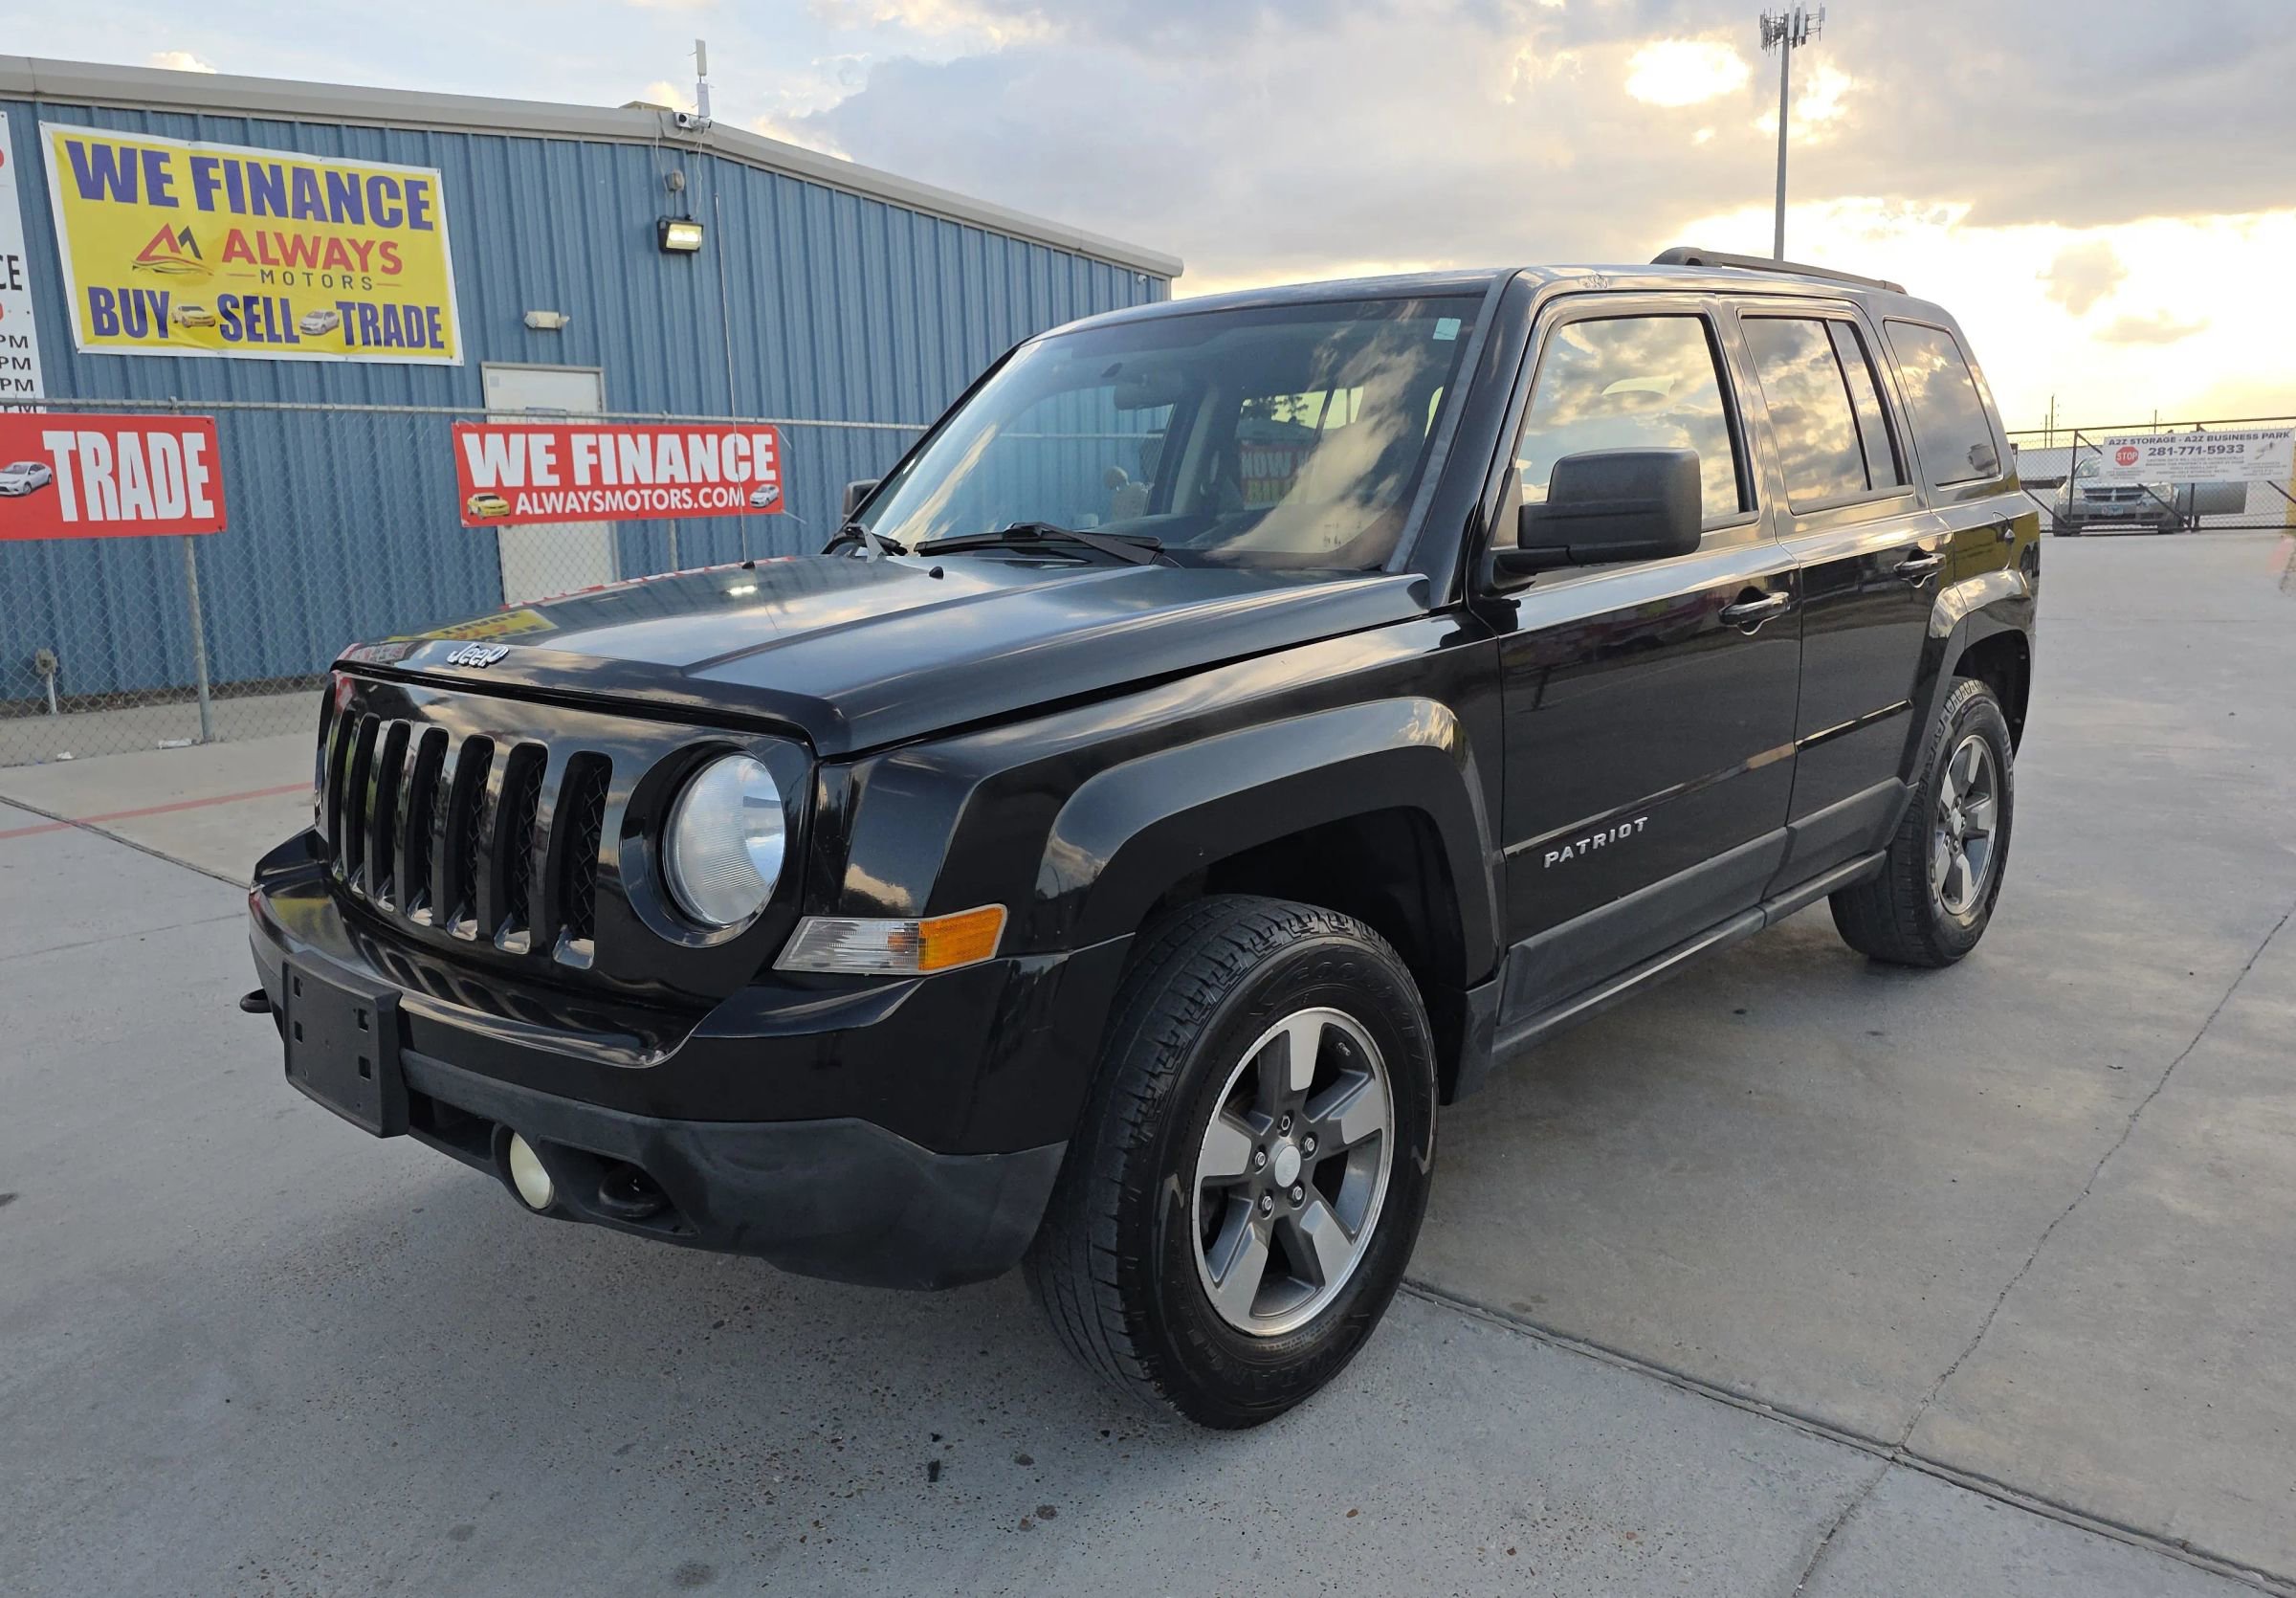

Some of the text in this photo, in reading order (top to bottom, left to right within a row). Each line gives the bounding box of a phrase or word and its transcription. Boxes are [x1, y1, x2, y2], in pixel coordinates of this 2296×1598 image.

[65, 140, 433, 232] WE FINANCE
[221, 228, 403, 276] ALWAYS
[260, 269, 373, 291] MOTORS
[88, 286, 445, 349] BUY SELL TRADE
[0, 377, 34, 391] PM
[2130, 436, 2176, 445] STORAGE
[2206, 433, 2259, 442] BUSINESS
[2148, 443, 2245, 456] 281-771-5933
[461, 433, 777, 488] WE FINANCE
[2116, 452, 2138, 460] STOP
[41, 430, 215, 522] TRADE
[515, 486, 746, 516] ALWAYSMOTORS.COM
[447, 642, 509, 667] Jeep
[1543, 816, 1648, 869] PATRIOT
